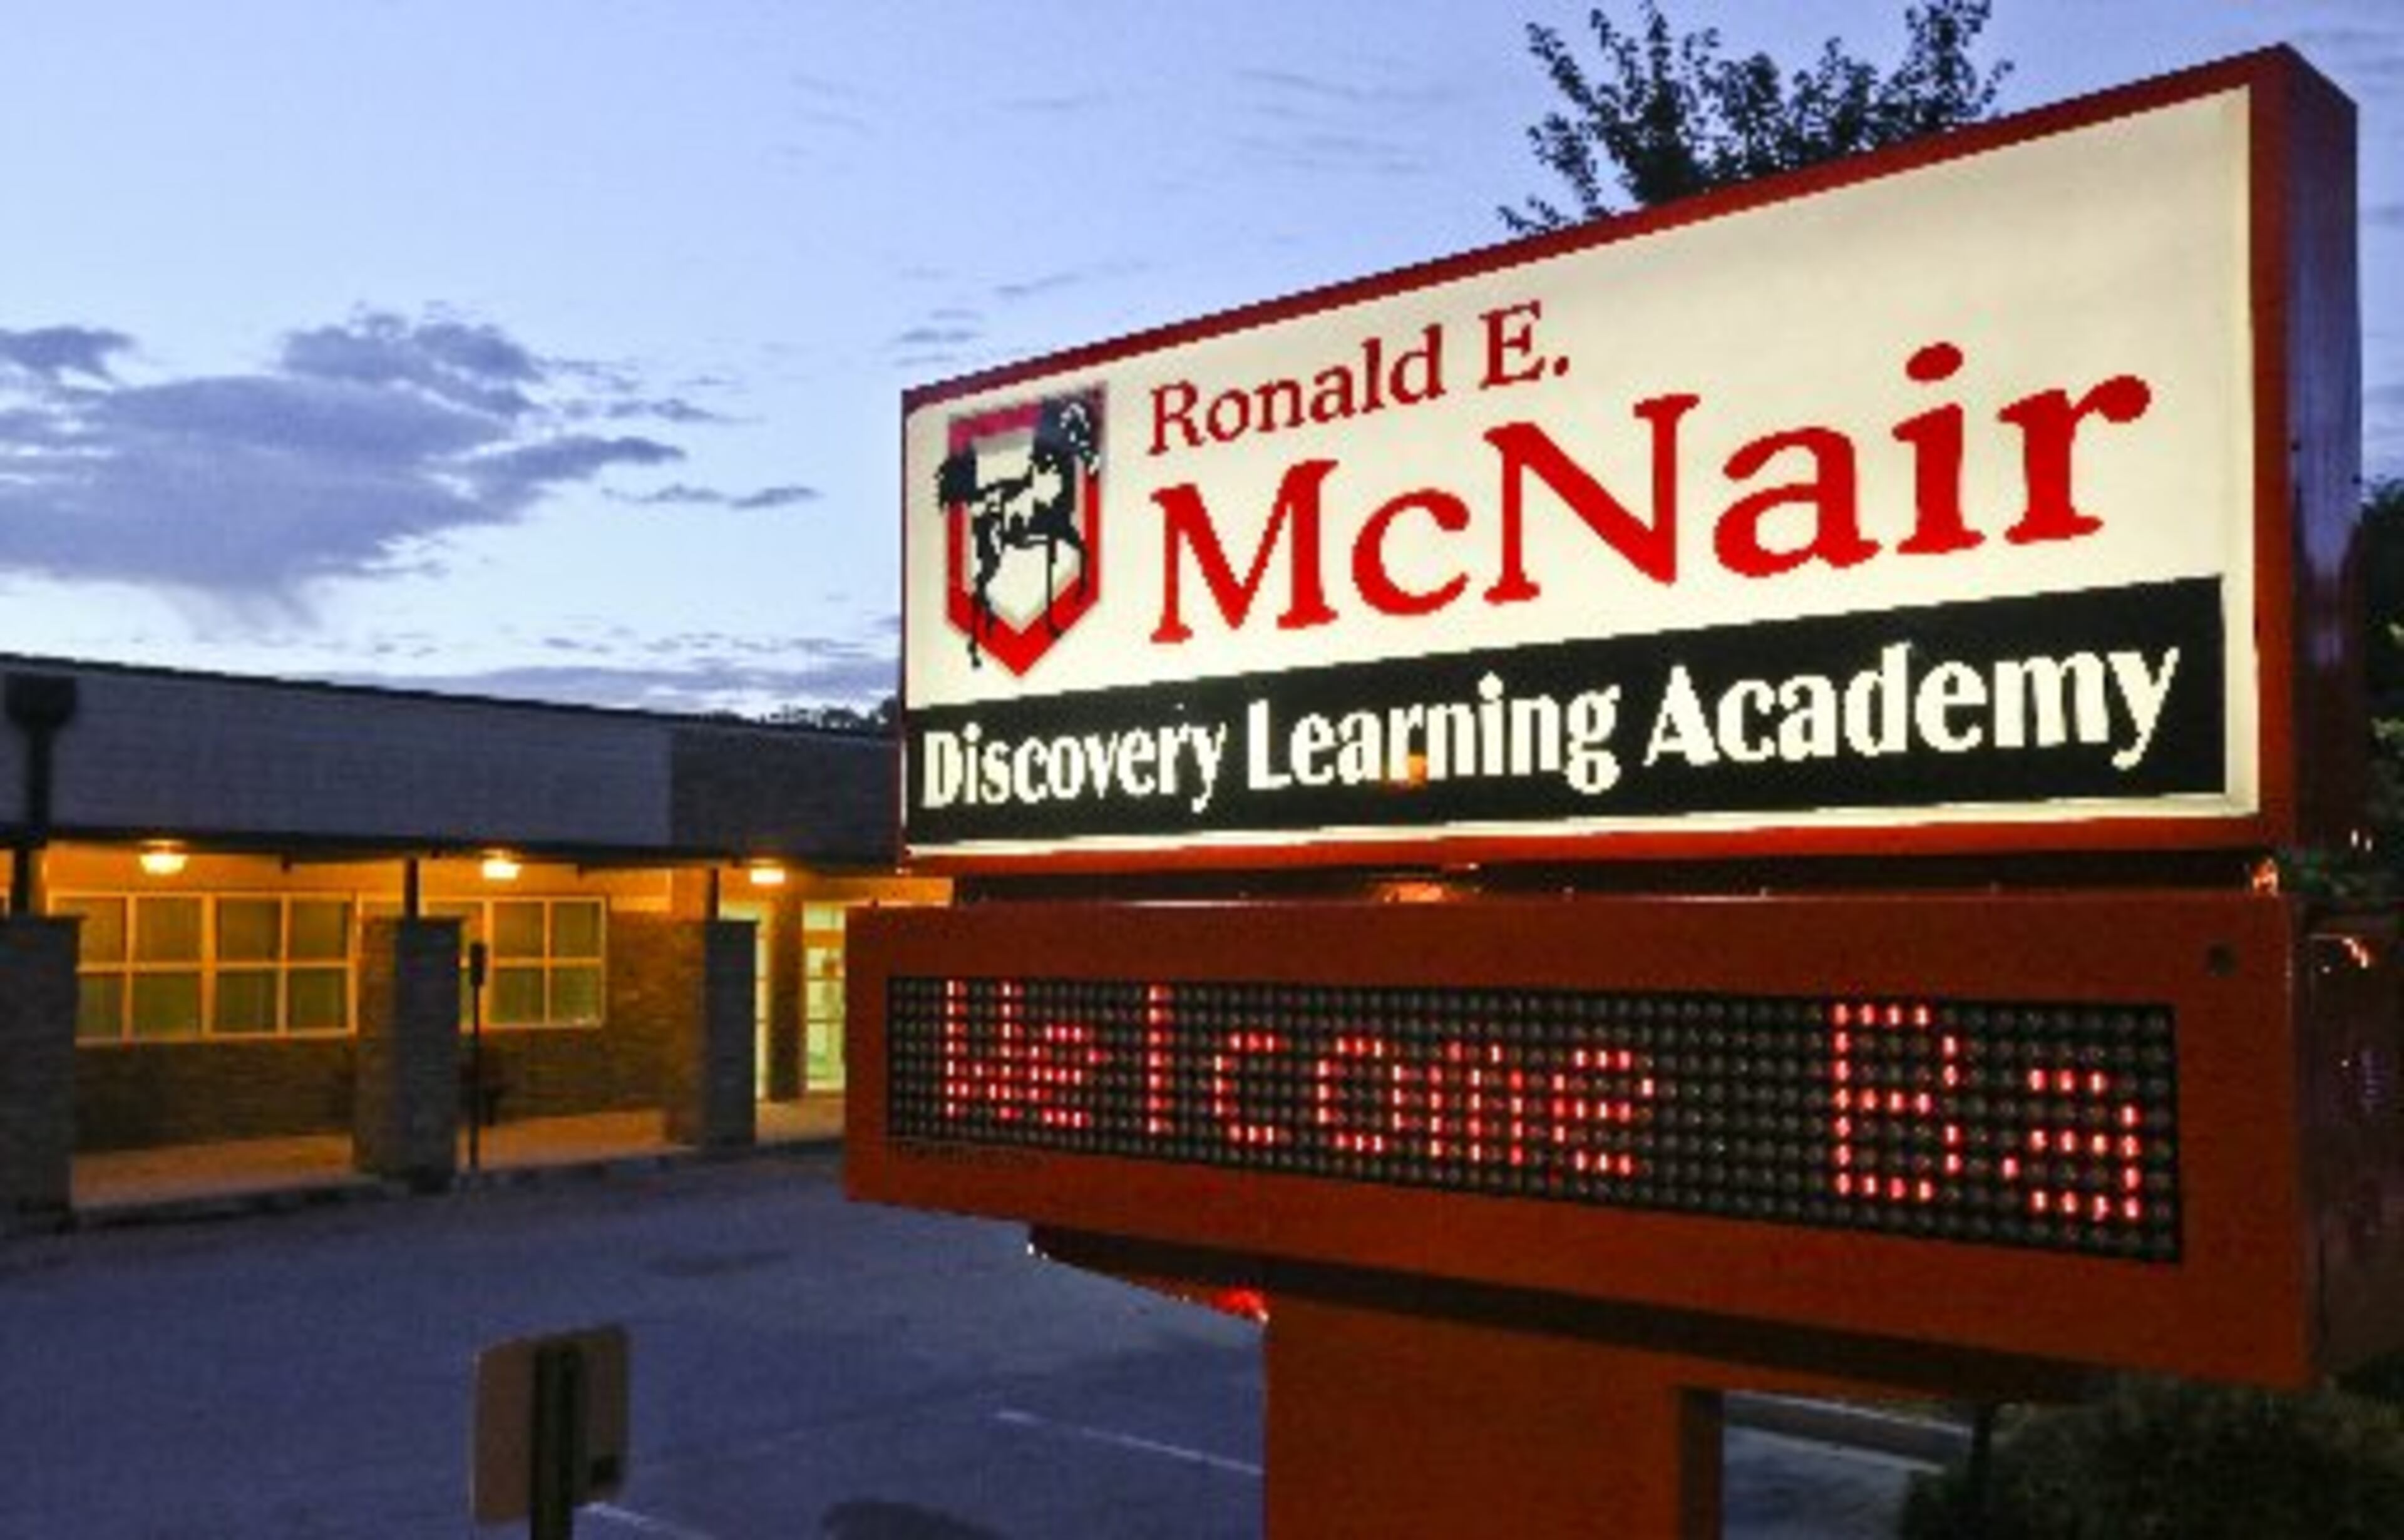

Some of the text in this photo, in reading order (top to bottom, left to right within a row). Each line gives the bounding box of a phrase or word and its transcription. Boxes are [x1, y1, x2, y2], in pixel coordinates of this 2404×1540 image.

[1148, 300, 1569, 455] Ronald E.
[1150, 342, 2151, 644] McNair
[923, 640, 2180, 813] Discovery Learning Academy
[946, 979, 1655, 1175] Welcome
